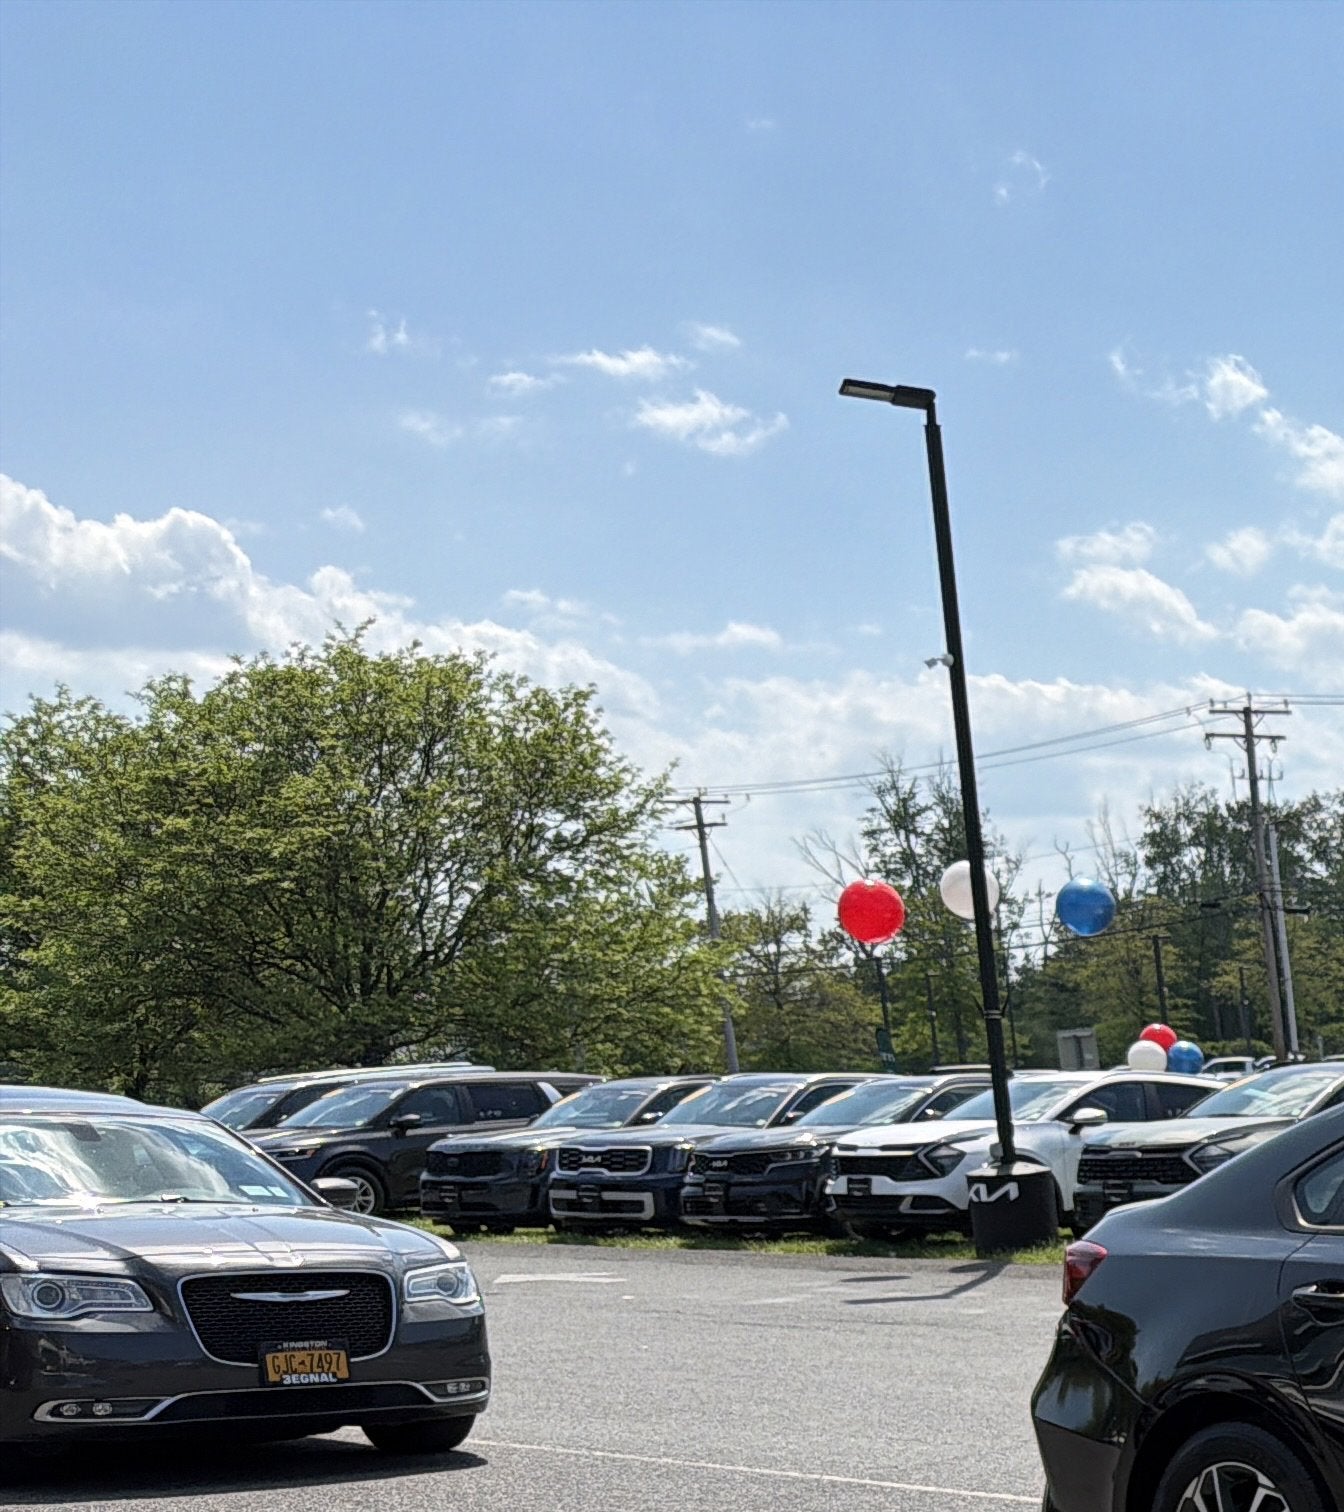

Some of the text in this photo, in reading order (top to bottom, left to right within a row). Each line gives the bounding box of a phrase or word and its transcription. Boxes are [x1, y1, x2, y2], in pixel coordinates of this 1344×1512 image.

[282, 1340, 328, 1349] KINGSTON
[271, 1352, 341, 1375] GJC 7497
